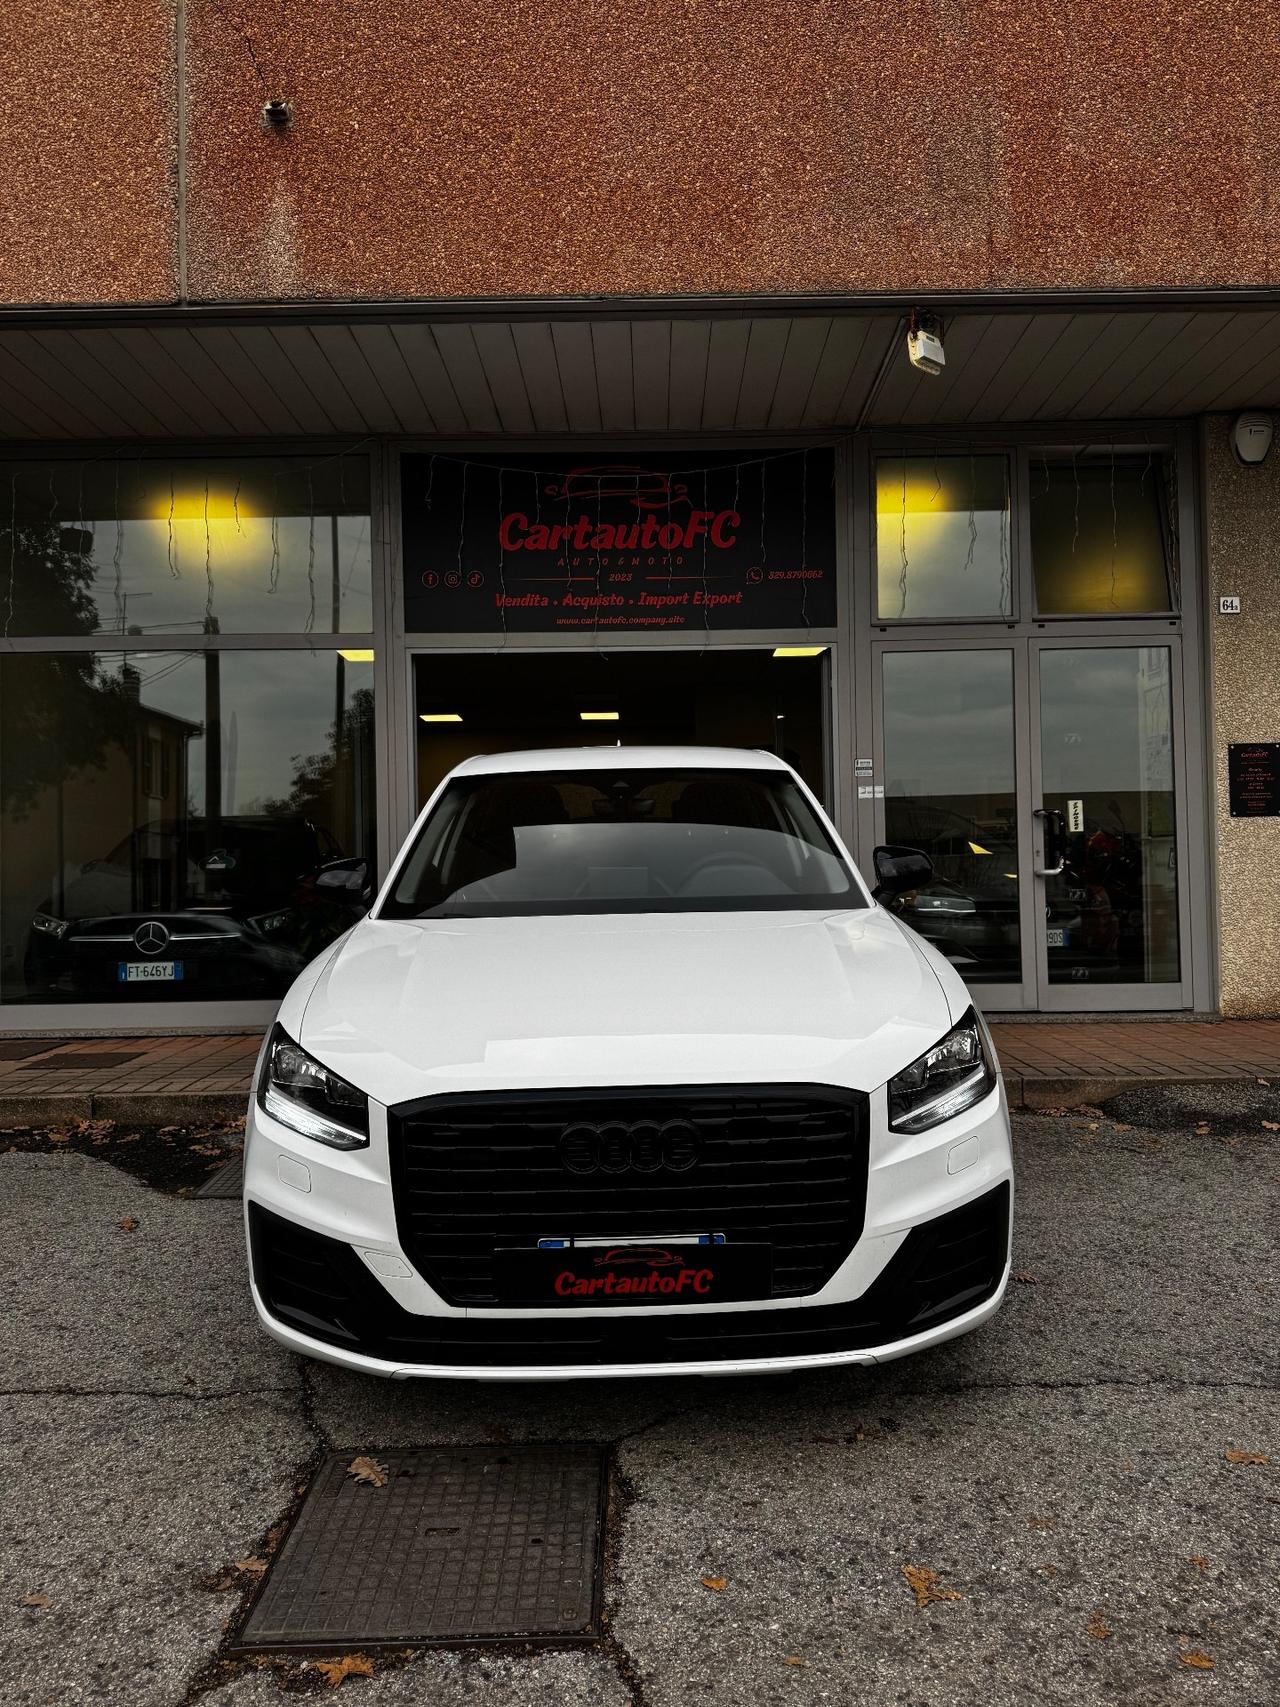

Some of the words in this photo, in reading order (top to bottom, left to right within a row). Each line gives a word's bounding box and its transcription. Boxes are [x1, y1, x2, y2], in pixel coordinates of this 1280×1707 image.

[501, 510, 741, 551] CartautoFC
[608, 572, 633, 583] 2023
[495, 592, 549, 607] Vendita
[562, 592, 625, 609] Acquisto
[638, 591, 689, 608] Import
[692, 591, 743, 607] Export
[554, 1269, 714, 1297] CartautoFC
